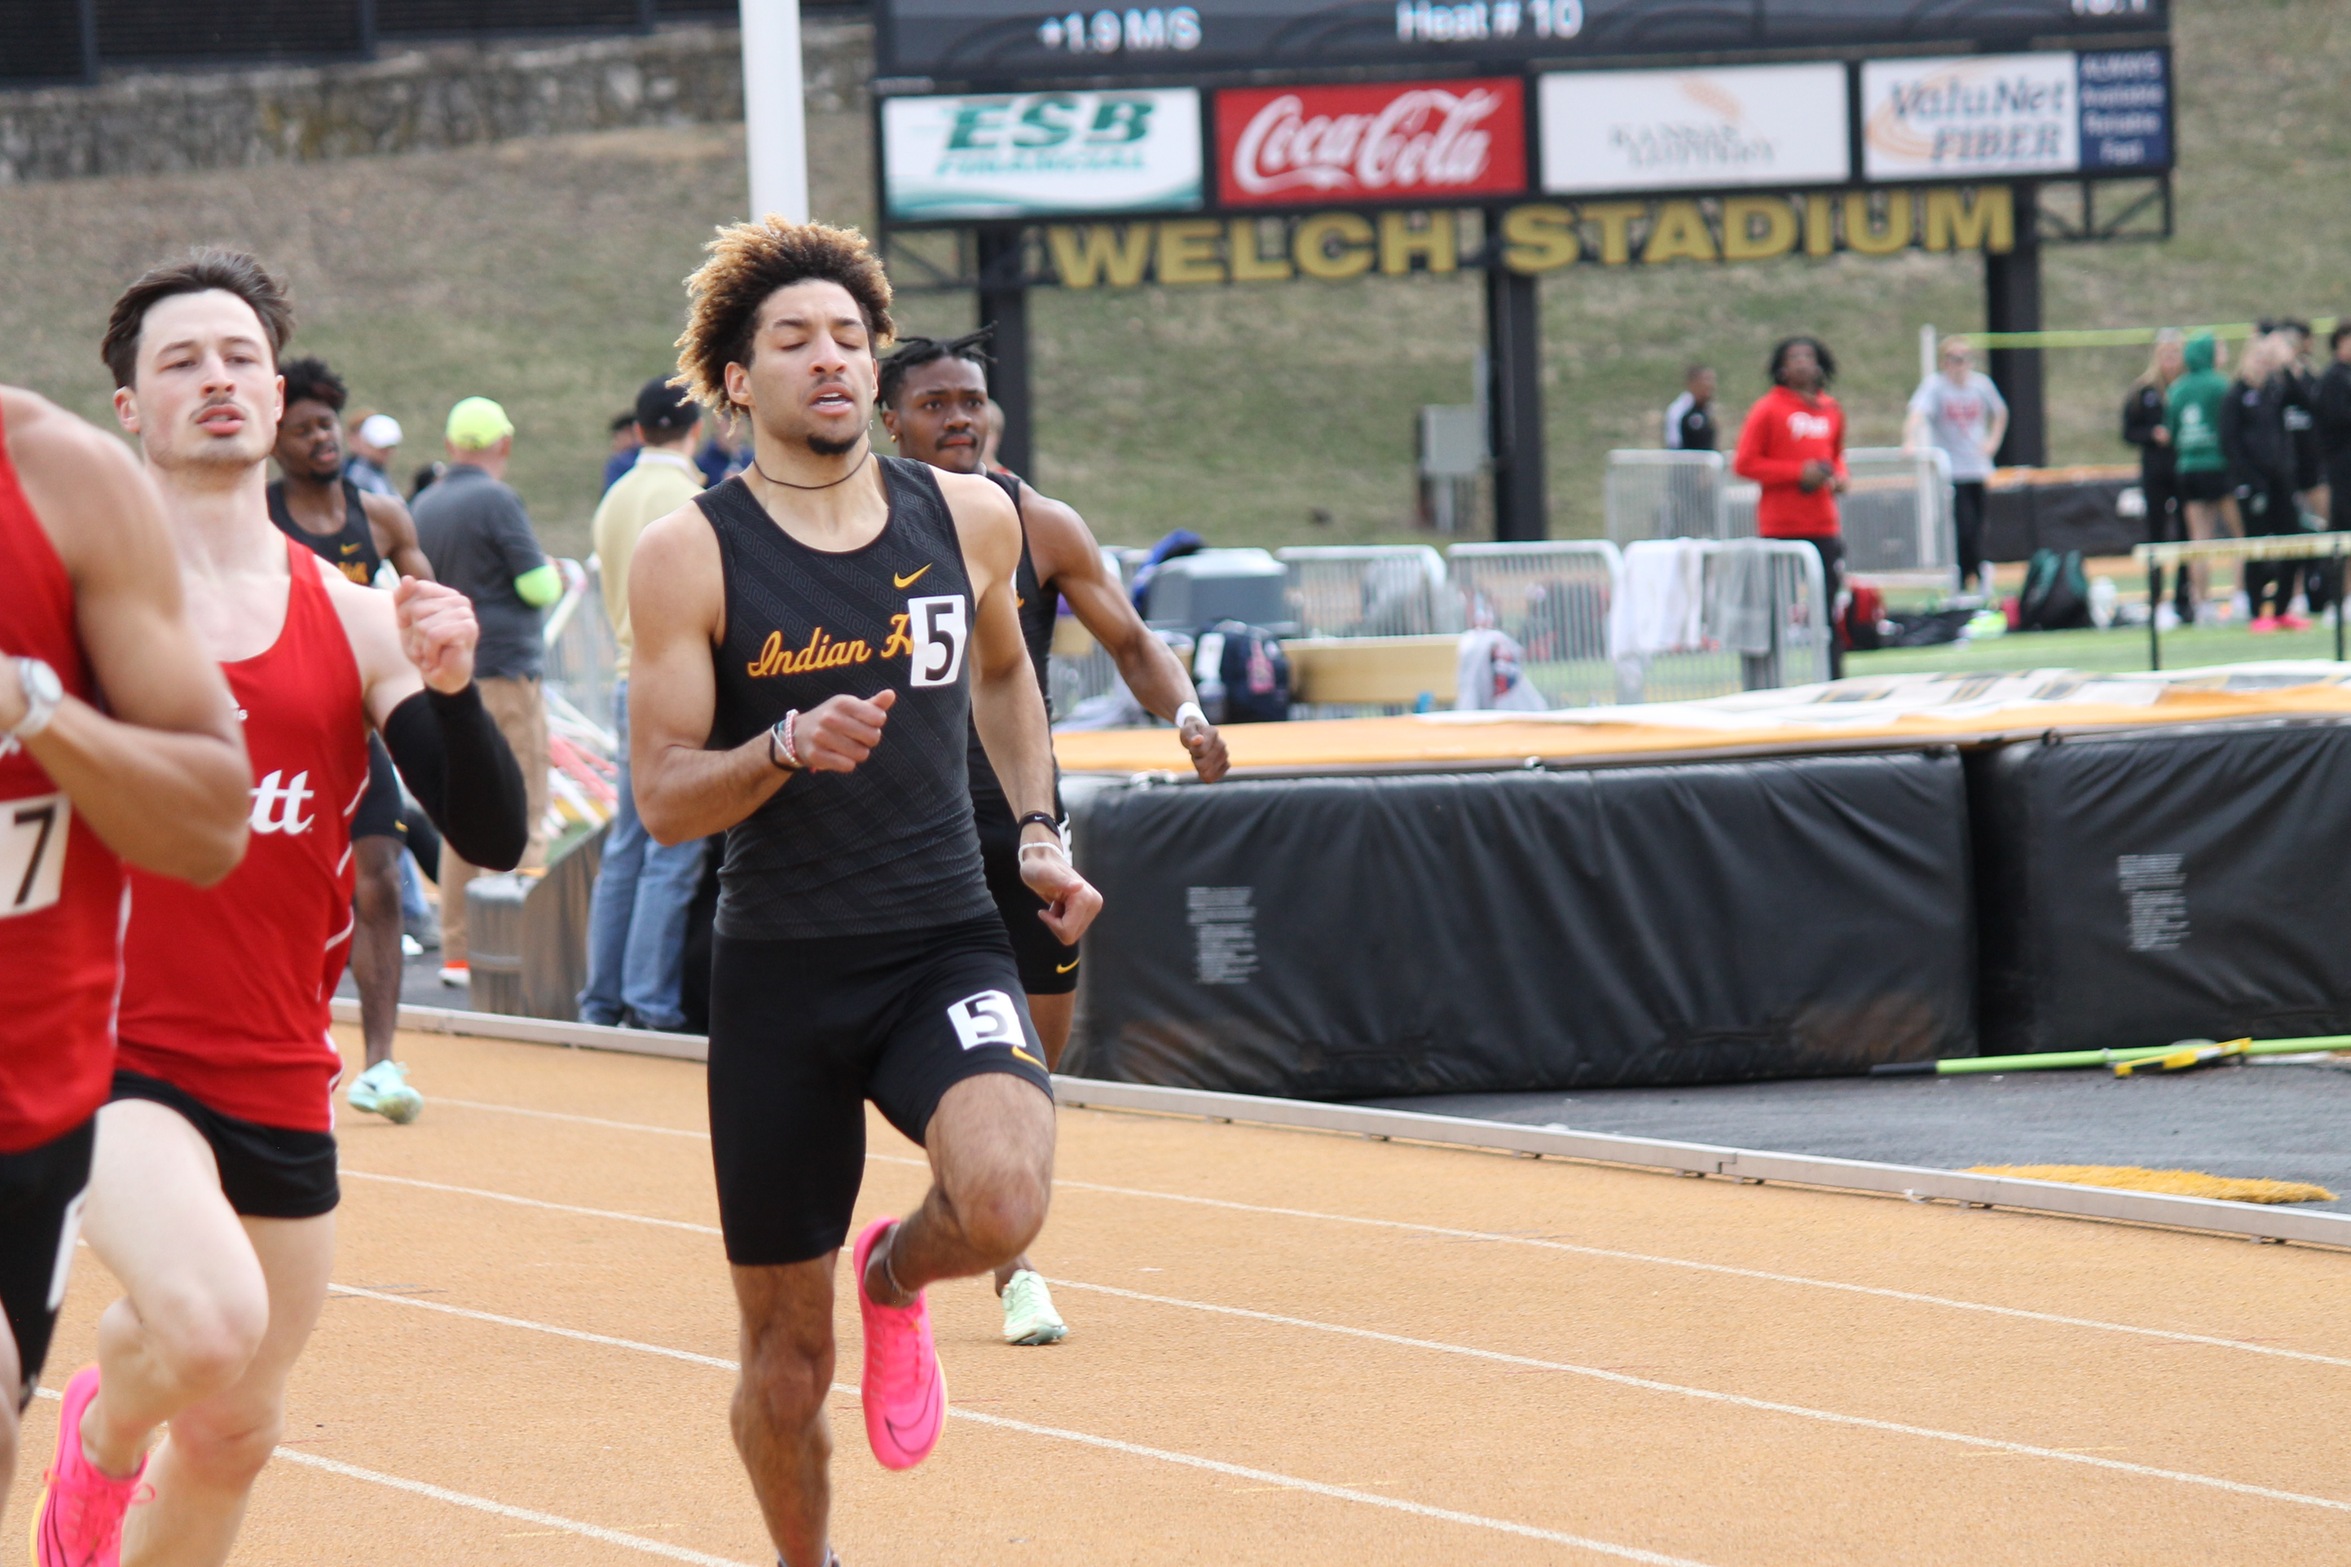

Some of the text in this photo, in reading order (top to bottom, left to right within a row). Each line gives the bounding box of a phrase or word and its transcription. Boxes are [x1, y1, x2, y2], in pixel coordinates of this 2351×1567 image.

[1124, 6, 1202, 51] M/S
[1396, 0, 1490, 42] Heat
[1528, 0, 1583, 39] 10
[948, 90, 1154, 150] ESB
[1232, 88, 1502, 194] Coca Cola
[1930, 121, 2062, 162] FIBER
[1046, 187, 2014, 289] WELCH STADIUM
[747, 626, 872, 678] Indian
[924, 601, 956, 682] 5
[13, 803, 57, 906] 7
[963, 994, 1009, 1039] 5
